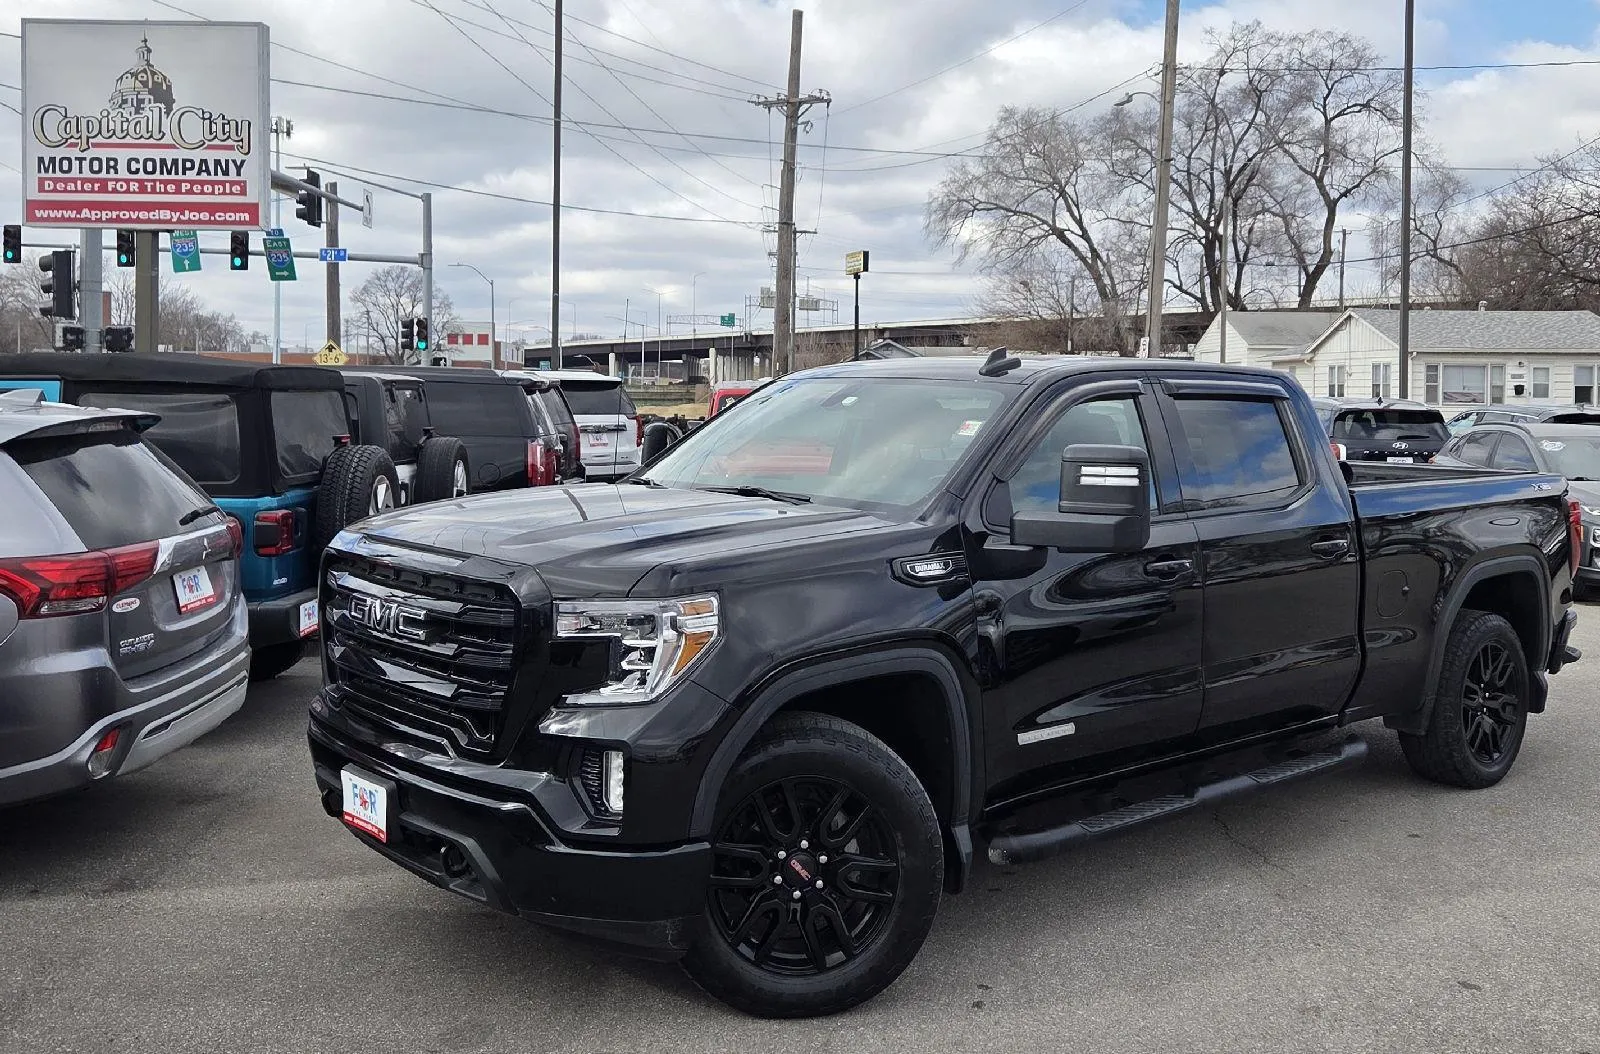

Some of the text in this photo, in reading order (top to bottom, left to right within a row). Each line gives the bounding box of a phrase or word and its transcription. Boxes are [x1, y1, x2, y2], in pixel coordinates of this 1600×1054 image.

[33, 104, 251, 155] Capital City
[37, 156, 246, 176] MOTOR COMPANY
[44, 180, 242, 195] Dealer FOR The People
[35, 208, 250, 222] www.ApprovedByJoe.com
[175, 242, 195, 252] 235
[270, 253, 289, 262] 235
[914, 562, 946, 573] DURAMAX
[349, 593, 428, 641] GMC
[351, 782, 378, 817] FOR
[790, 859, 811, 881] GMC
